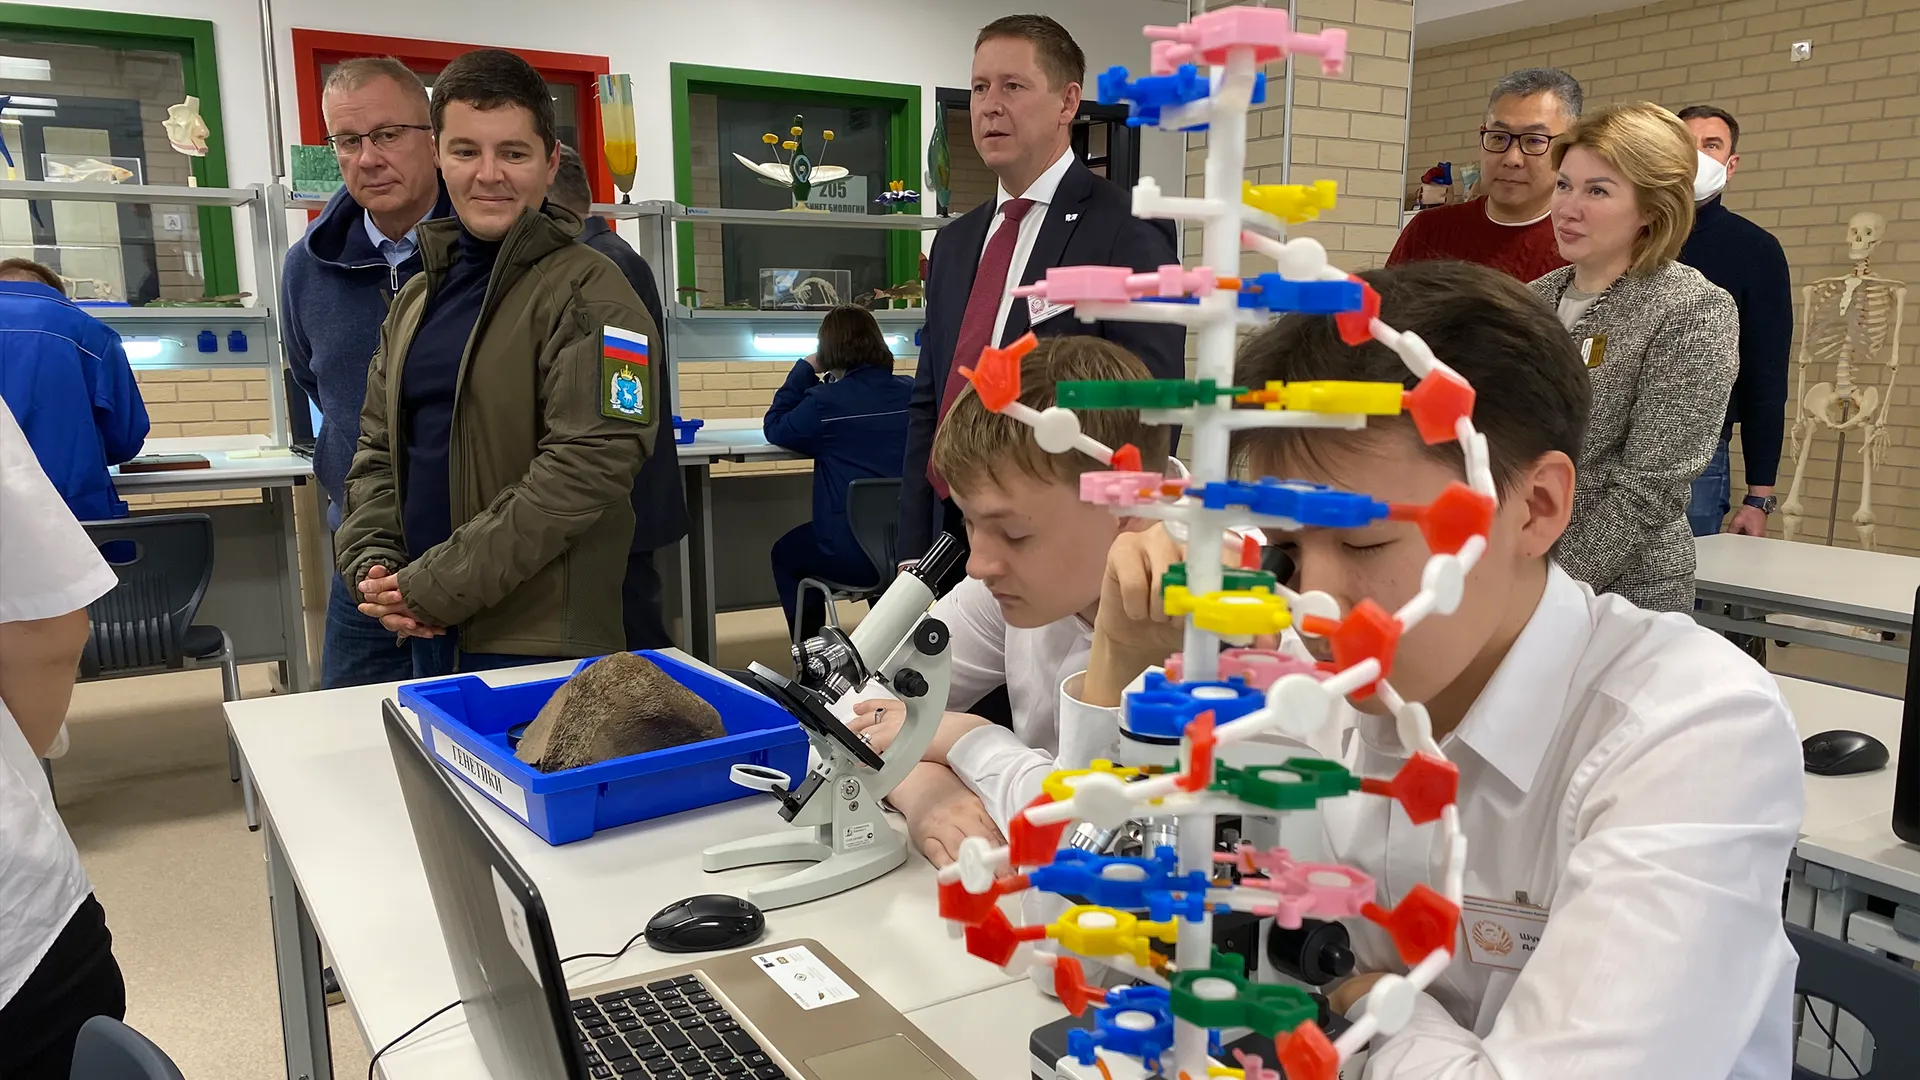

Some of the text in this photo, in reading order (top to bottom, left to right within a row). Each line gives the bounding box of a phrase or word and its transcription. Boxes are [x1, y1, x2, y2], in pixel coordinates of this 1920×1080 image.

[819, 182, 846, 198] 205
[829, 203, 865, 213] БИОЛОГИИ
[451, 744, 503, 794] ГЕНЕТИКИ
